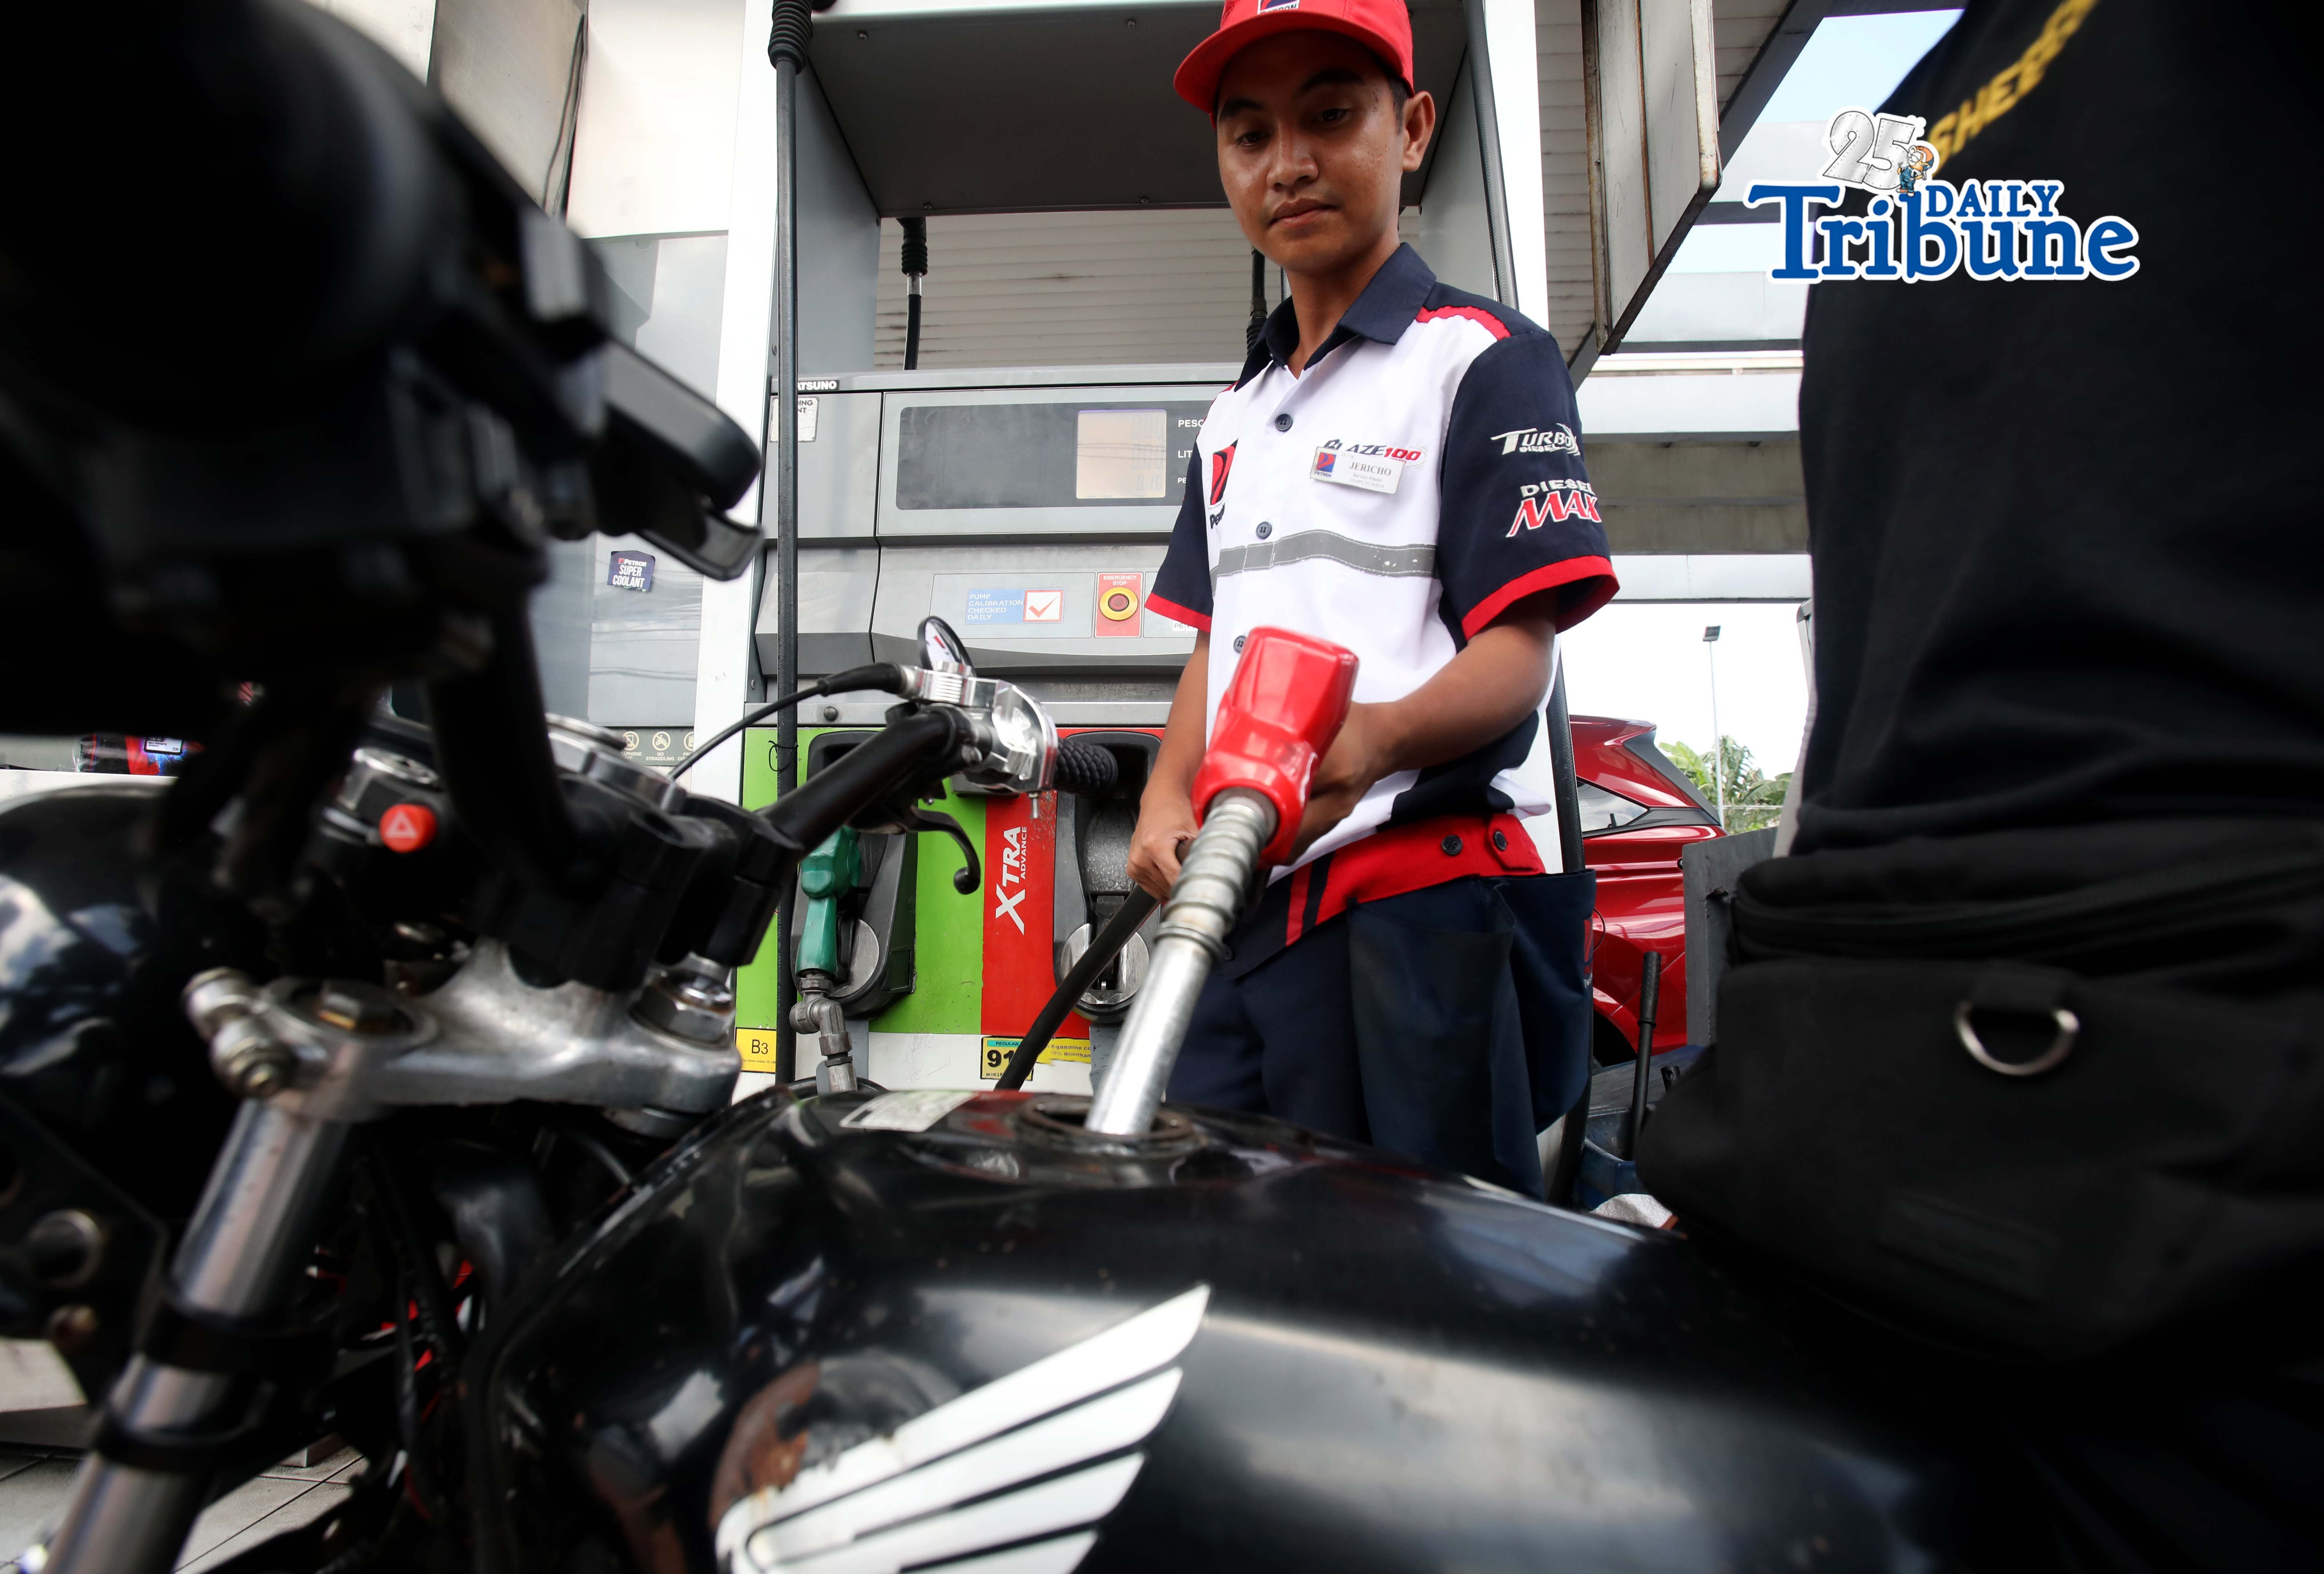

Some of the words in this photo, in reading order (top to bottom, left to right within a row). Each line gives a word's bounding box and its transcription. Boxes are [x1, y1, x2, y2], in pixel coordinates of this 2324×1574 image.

[1519, 443, 1560, 453] DIESEL
[1349, 462, 1392, 476] JERICHO
[1520, 478, 1596, 498] DIESEL
[1505, 490, 1602, 538] MAX
[624, 558, 647, 567] PETRON
[619, 565, 643, 577] SUPER
[612, 574, 646, 588] COOLANT
[995, 826, 1026, 936] XTRA
[752, 1039, 768, 1055] B3
